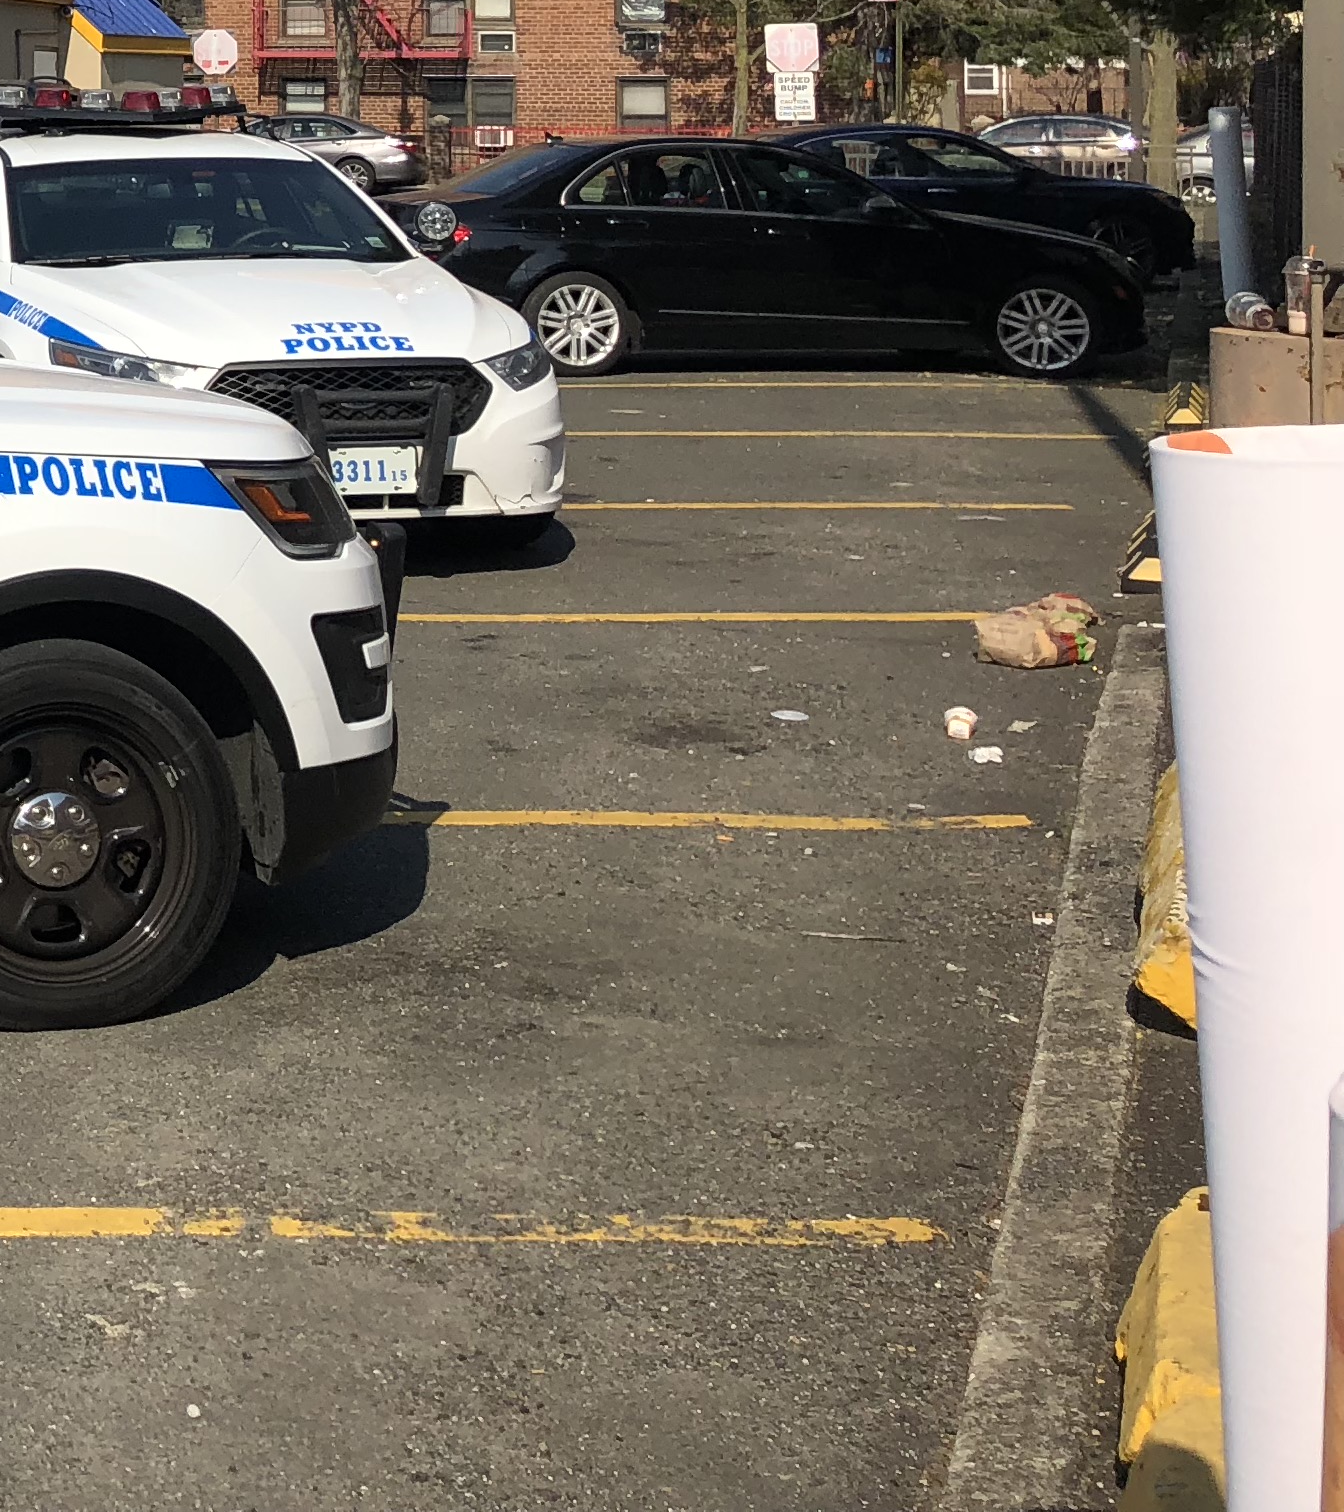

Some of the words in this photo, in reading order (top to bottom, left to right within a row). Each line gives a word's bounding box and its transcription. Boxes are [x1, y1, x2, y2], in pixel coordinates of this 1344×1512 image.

[770, 38, 815, 58] STOP
[777, 76, 811, 84] SPEED
[9, 300, 50, 331] POLICE
[291, 322, 382, 334] NYPD
[280, 336, 415, 355] POLICE
[13, 455, 164, 502] POLICE
